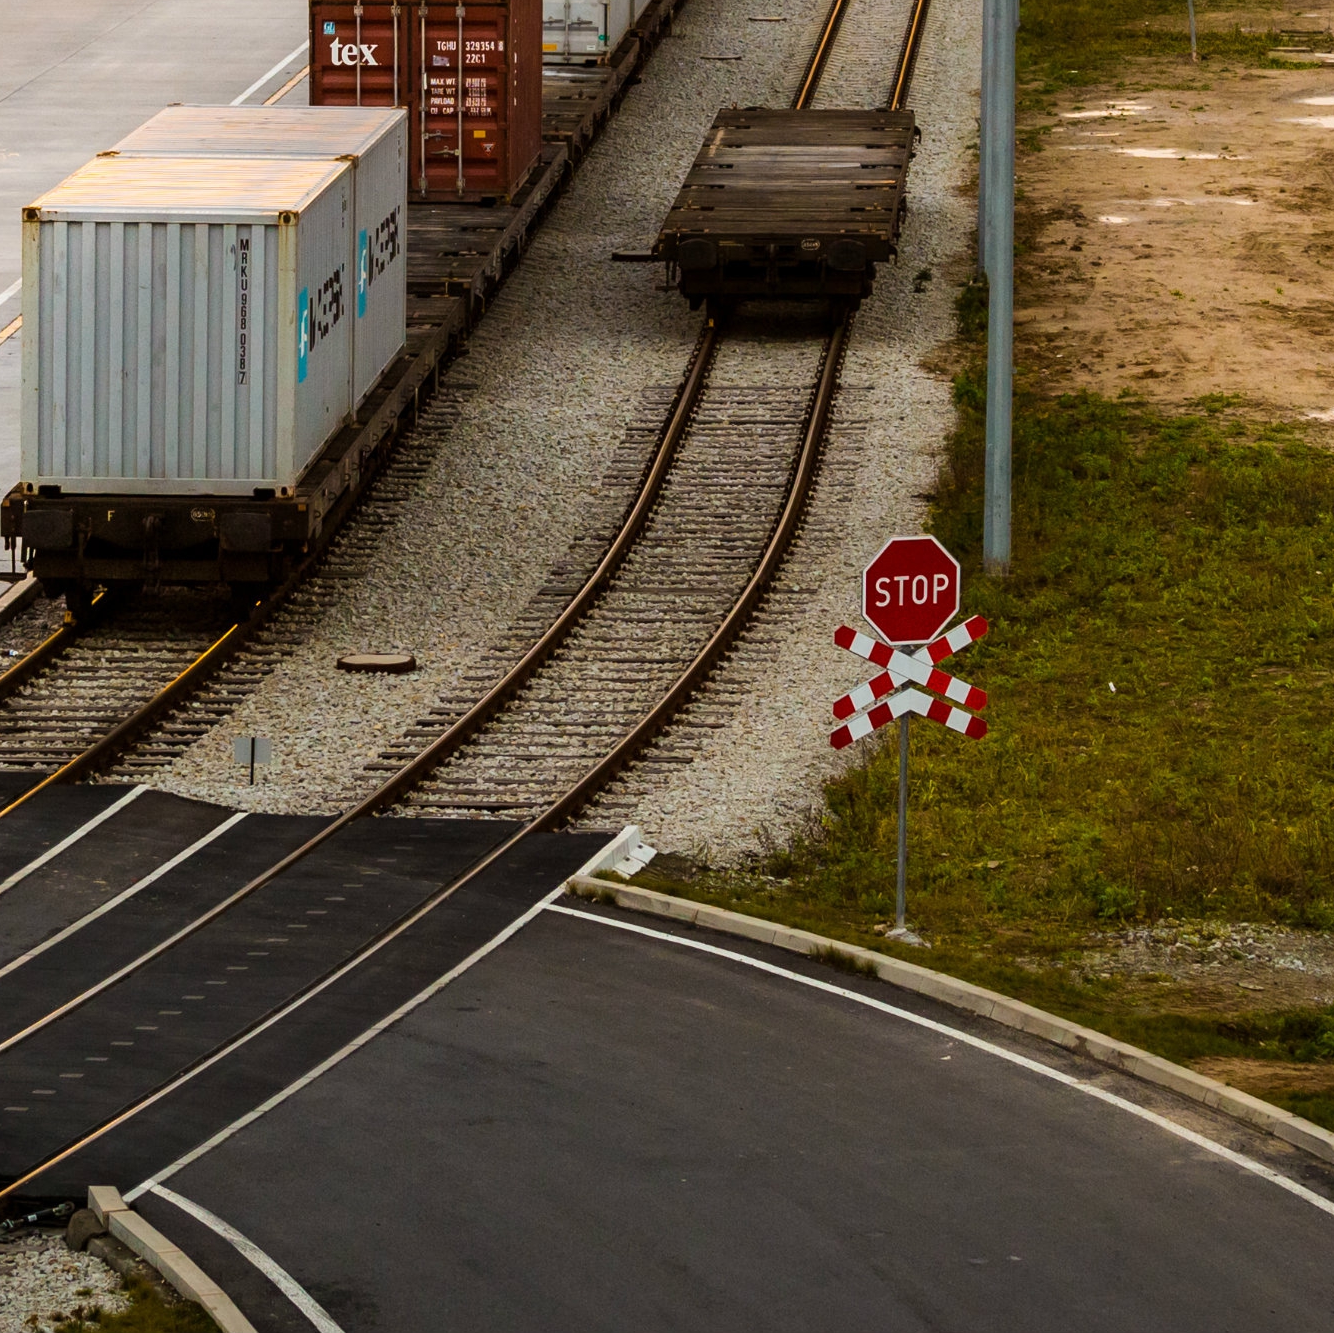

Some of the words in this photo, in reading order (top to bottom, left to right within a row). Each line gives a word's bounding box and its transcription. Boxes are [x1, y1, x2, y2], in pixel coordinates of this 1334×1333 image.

[329, 36, 379, 66] tex
[436, 40, 457, 51] TGHU
[465, 41, 495, 51] 329354
[430, 97, 455, 105] PAYLOAD
[875, 573, 950, 608] STOP
